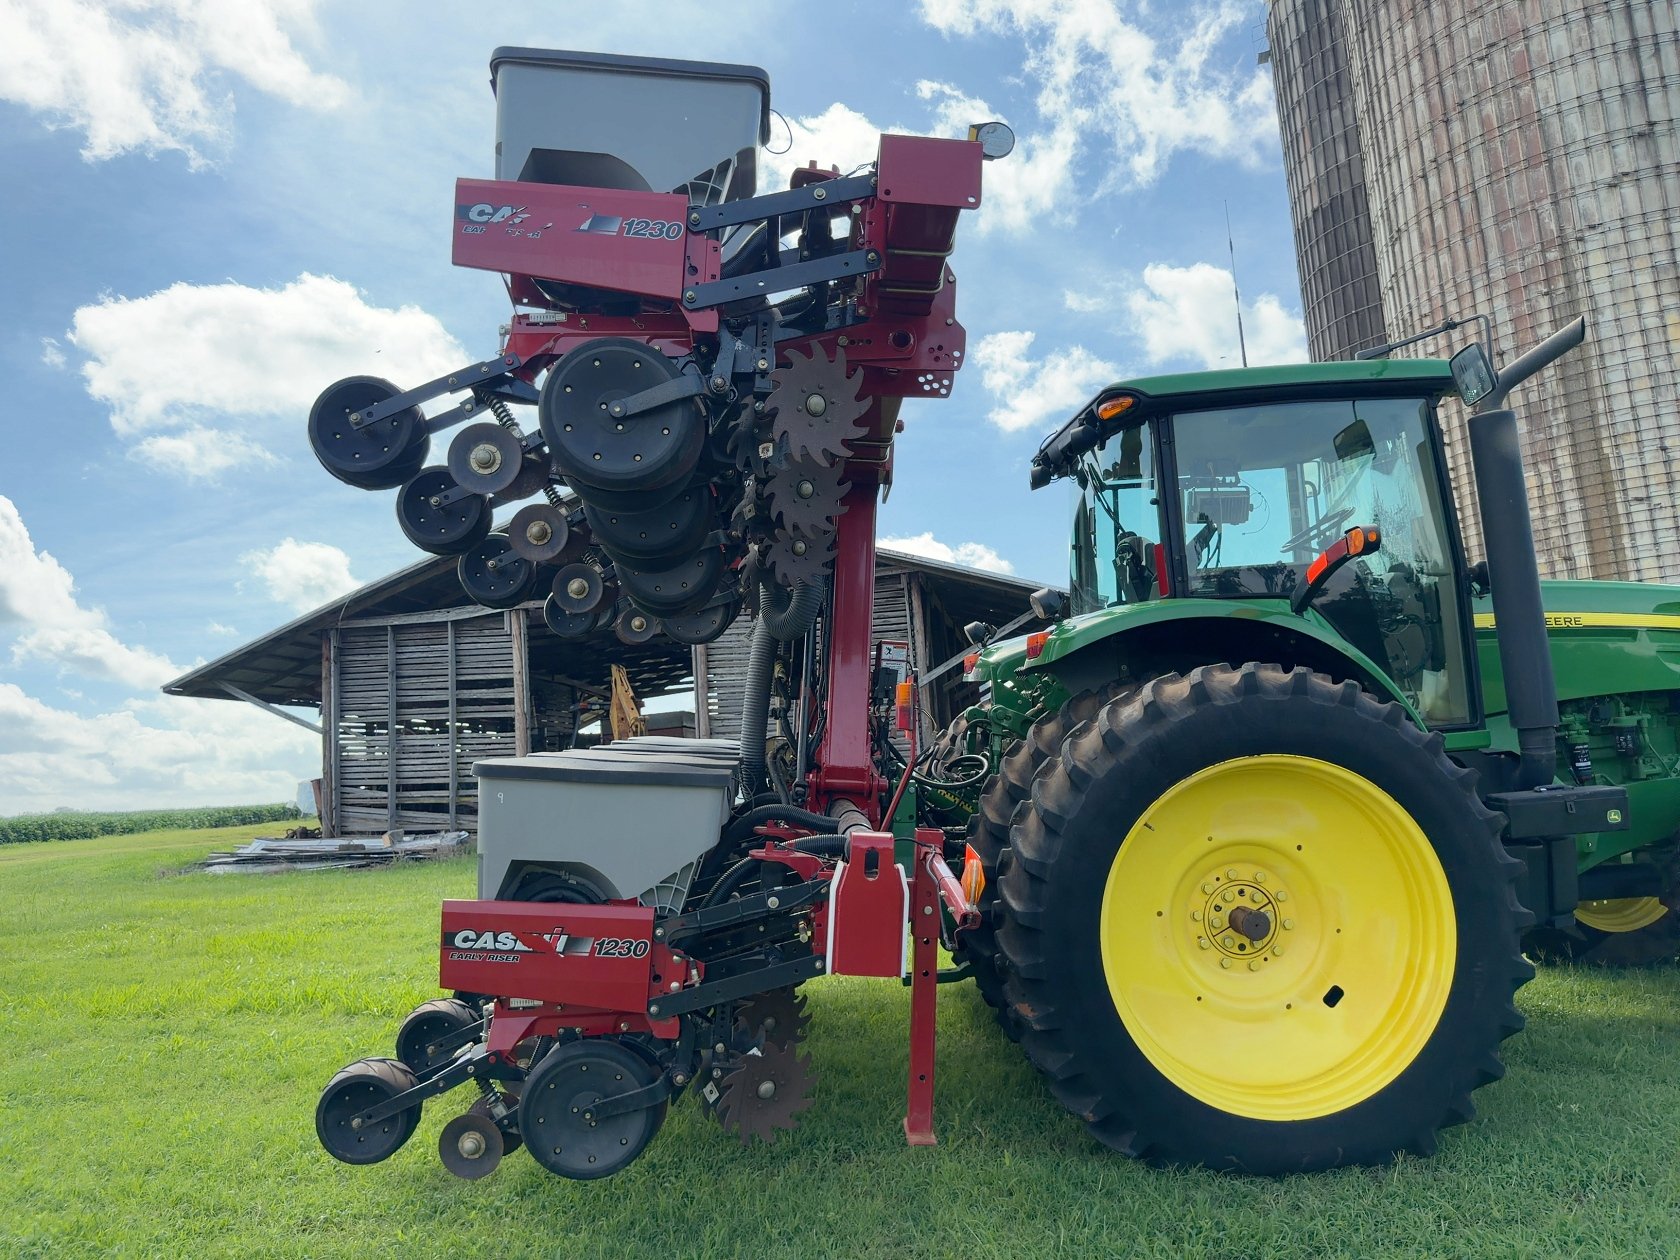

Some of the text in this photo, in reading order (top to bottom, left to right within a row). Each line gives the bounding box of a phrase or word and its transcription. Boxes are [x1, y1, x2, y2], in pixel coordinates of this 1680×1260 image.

[623, 218, 684, 241] 1230
[1544, 616, 1583, 626] EERE
[497, 792, 504, 804] 9
[595, 937, 650, 958] 1230
[449, 952, 520, 963] EARLY RISER
